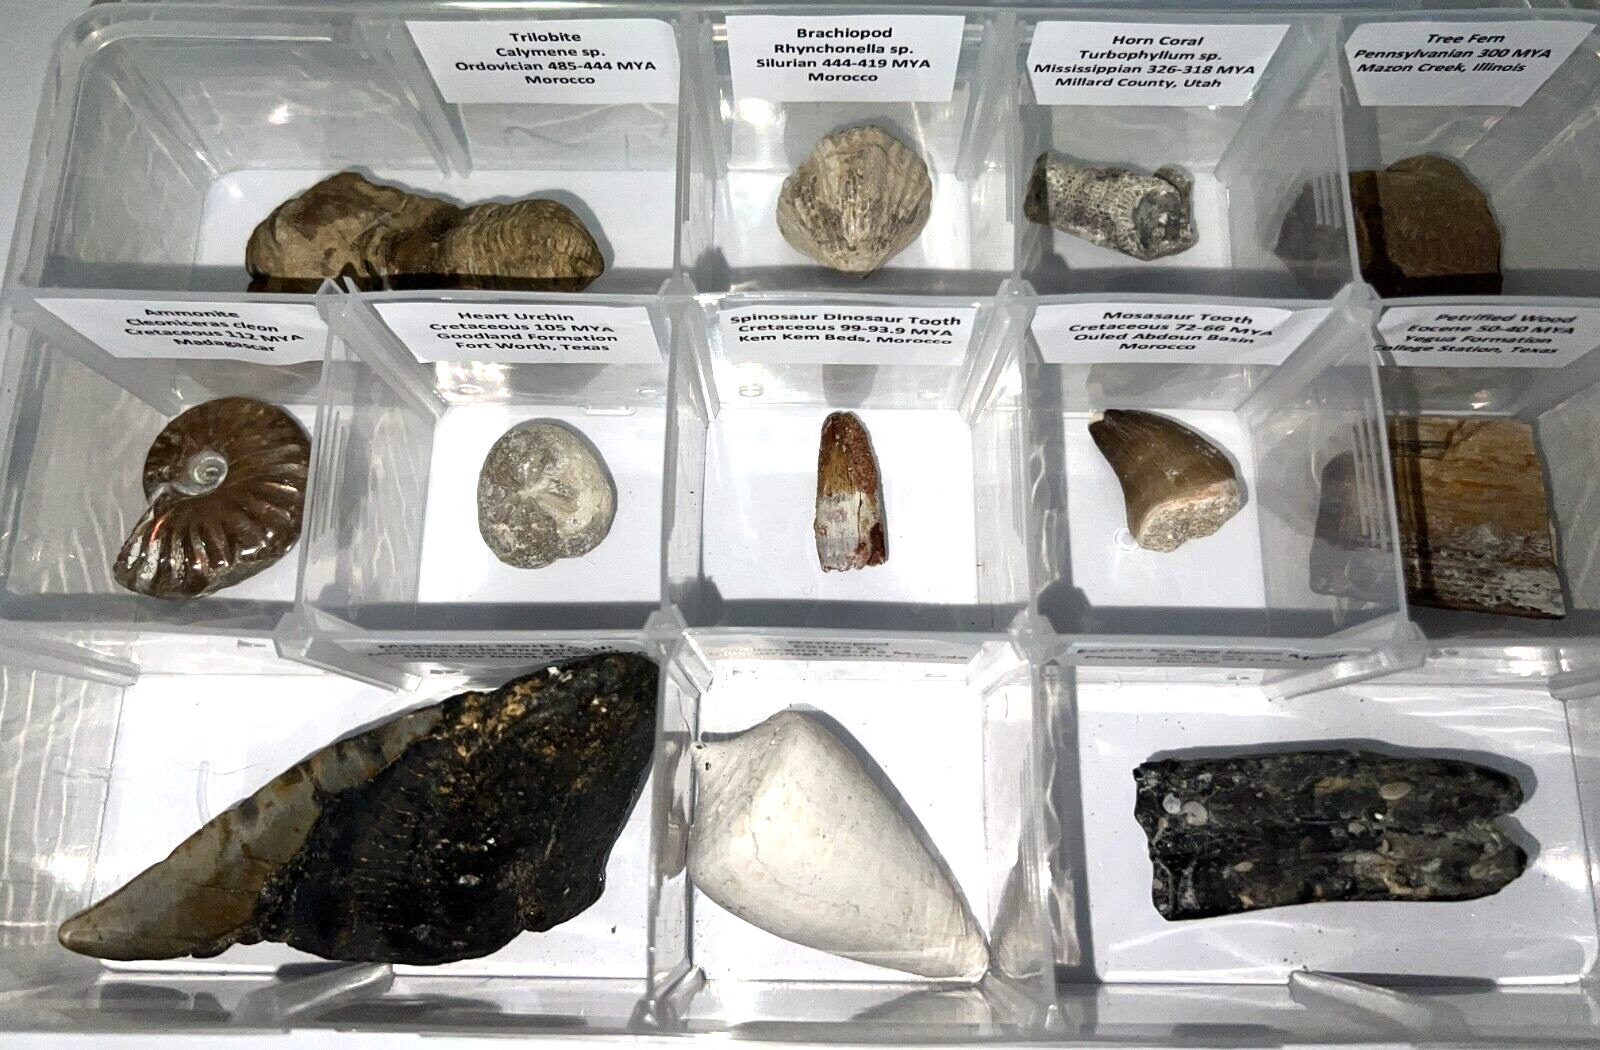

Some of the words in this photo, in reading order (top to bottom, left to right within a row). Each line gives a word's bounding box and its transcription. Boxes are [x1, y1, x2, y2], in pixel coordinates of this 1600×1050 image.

[509, 32, 582, 42] Trilobite
[796, 28, 893, 40] Brachiopod
[1426, 34, 1464, 44] Tree
[1467, 34, 1506, 43] Fern
[1112, 35, 1154, 46] Horn
[1158, 36, 1204, 46] Coral
[496, 47, 578, 58] Calymene
[582, 48, 606, 58] sp.
[774, 43, 885, 55] Rhynchonella
[890, 46, 914, 55] sp.
[1354, 49, 1474, 60] Pennsylvanian
[1477, 49, 1510, 58] 300
[1512, 49, 1551, 58] MYA
[1079, 50, 1195, 61] Turbophyllum
[1199, 53, 1222, 61] sp.
[455, 62, 543, 71] Ordovician
[548, 62, 613, 71] 485-444
[617, 62, 657, 71] MYA
[756, 58, 817, 68] Silurian
[822, 58, 888, 68] 444-419
[892, 59, 931, 69] MYA
[1357, 63, 1413, 73] Mazon
[1417, 63, 1467, 73] Creek,
[1472, 63, 1526, 72] Illinois
[1034, 64, 1142, 75] Mississippian
[1147, 65, 1213, 74] 326-318
[1216, 65, 1256, 75] MYA
[525, 75, 596, 85] Morocco
[808, 72, 879, 82] Morocco
[1055, 78, 1114, 87] Millard
[1118, 78, 1177, 89] County,
[1183, 79, 1222, 88] Utah
[144, 309, 240, 318] Ammonite
[458, 312, 509, 321] Heart
[514, 312, 575, 322] Urchin
[1102, 312, 1194, 321] Mosasaur
[1200, 313, 1254, 324] Tooth
[1435, 314, 1516, 322] Petrified
[1521, 315, 1578, 323] Wood
[126, 318, 229, 328] Cleoniceras
[233, 322, 279, 332] cleon
[730, 313, 818, 325] Spinosaur
[823, 313, 904, 323] Dinosaur
[908, 316, 961, 326] Tooth
[429, 323, 529, 331] Cretaceous
[535, 324, 567, 332] 105
[571, 325, 615, 333] MYA
[738, 324, 836, 333] Cretaceous
[840, 324, 906, 335] 99-93.9
[911, 328, 953, 337] MYA
[1069, 323, 1170, 332] Cretaceous
[1175, 323, 1225, 332] 72-66
[1229, 327, 1273, 336] MYA
[1407, 324, 1473, 332] Eocene
[1476, 325, 1528, 333] 50-40
[1532, 326, 1575, 334] MYA
[125, 328, 223, 338] Cretaceous
[227, 331, 259, 341] 112
[263, 333, 304, 343] MYA
[437, 332, 522, 341] Goodland
[528, 333, 618, 342] Formation
[739, 334, 777, 342] Kem
[825, 334, 871, 343] Beds,
[877, 336, 953, 345] Morocco
[1074, 333, 1127, 341] Ouled
[1132, 333, 1202, 341] Abdoun
[1207, 335, 1255, 344] Basin
[1404, 335, 1457, 343] Yegua
[1461, 335, 1553, 344] Formation
[173, 338, 276, 352] Madagascar
[455, 342, 493, 350] Fort
[498, 342, 556, 351] Worth,
[1439, 345, 1503, 353] Station,
[1510, 346, 1560, 354] Texas
